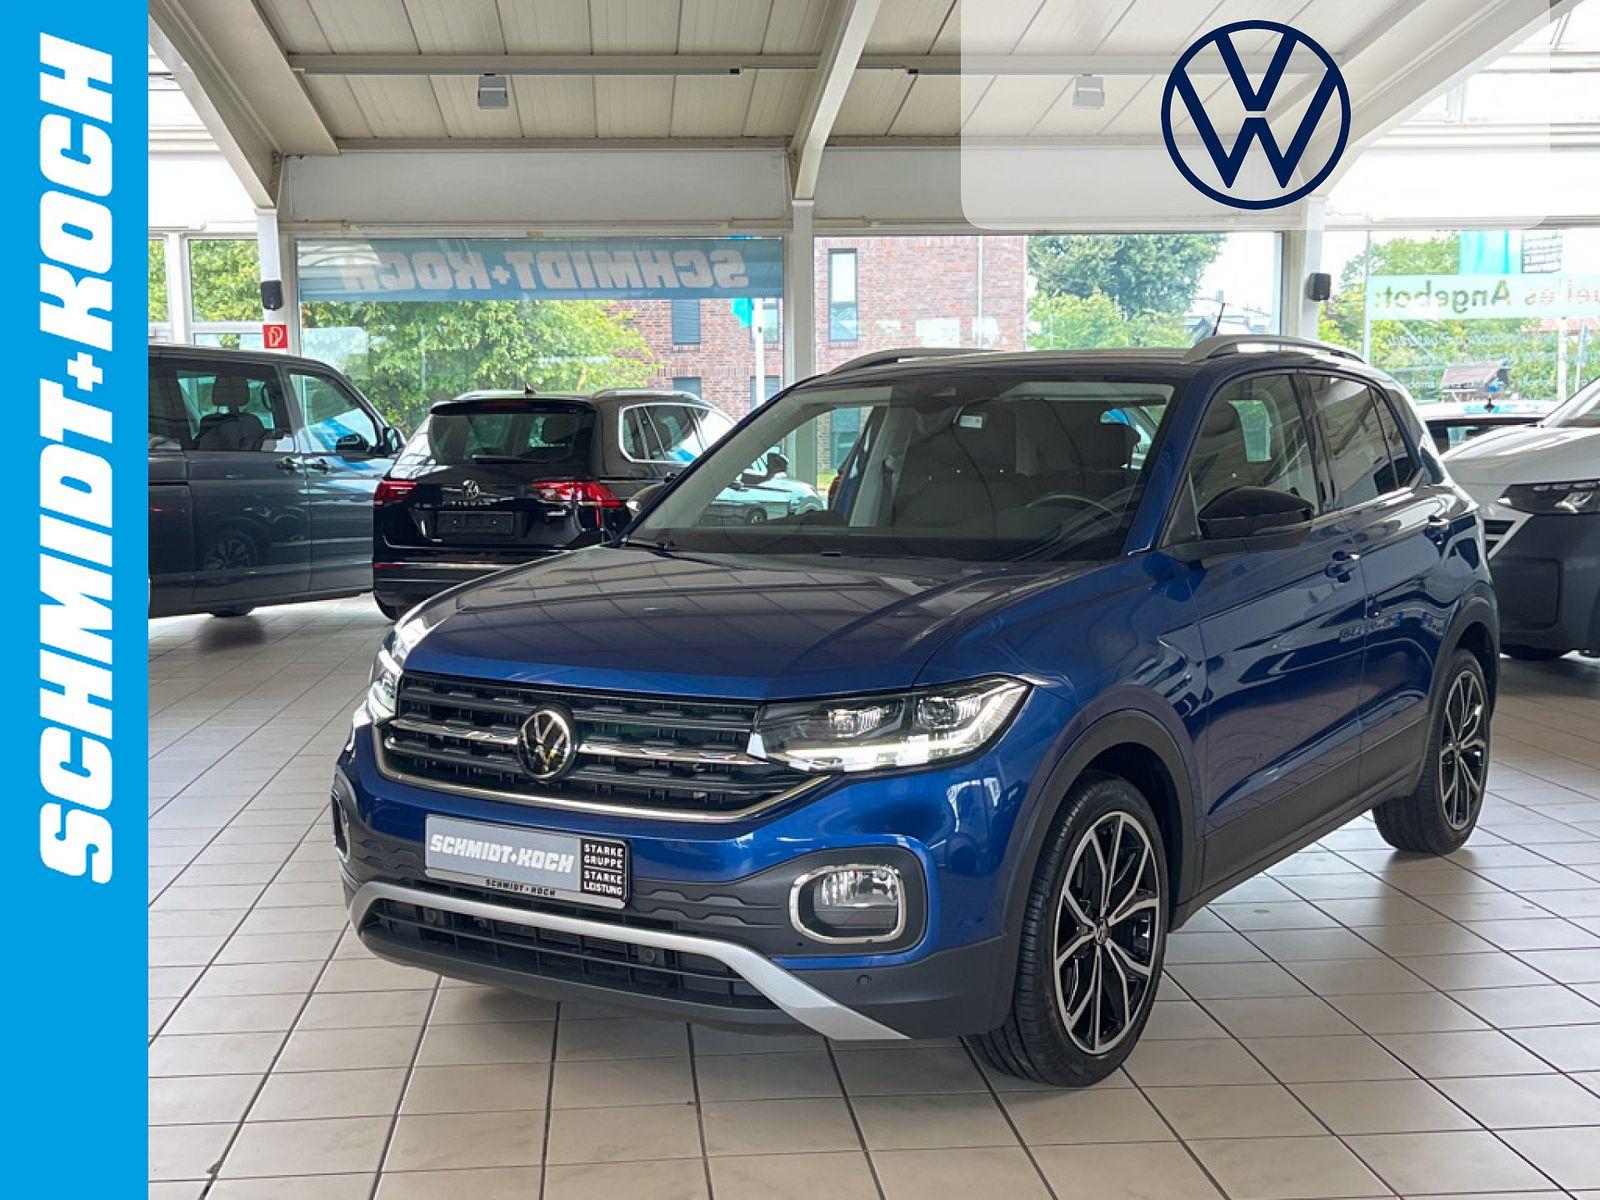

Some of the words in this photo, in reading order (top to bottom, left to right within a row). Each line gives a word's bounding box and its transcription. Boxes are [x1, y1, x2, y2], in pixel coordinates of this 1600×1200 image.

[429, 833, 575, 874] SCHMIDT+KOCH
[584, 843, 624, 858] STARKE
[584, 854, 623, 869] GRUPPE
[584, 870, 623, 885] STARKE
[584, 880, 623, 896] LEISTUNG
